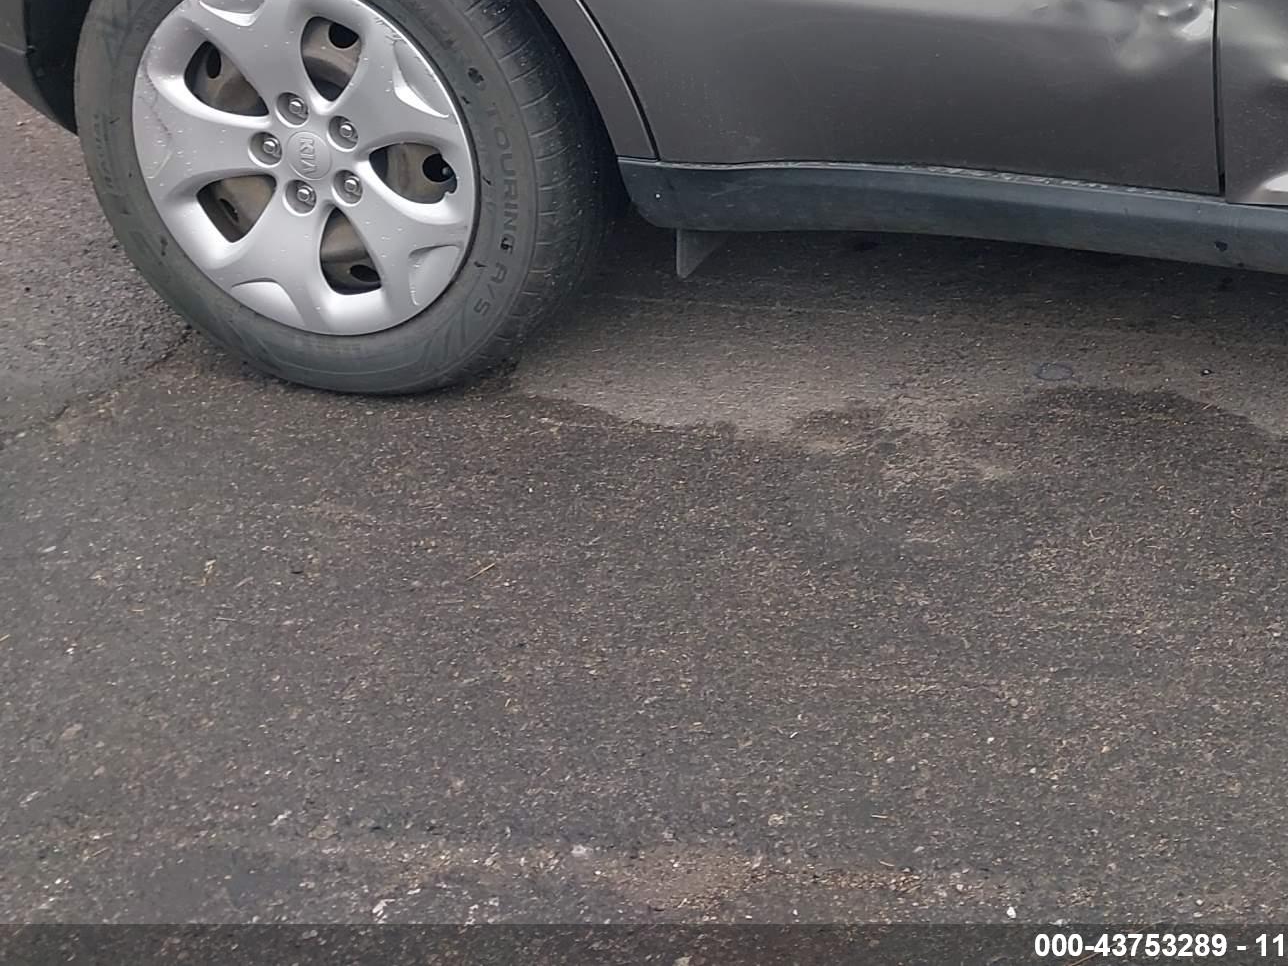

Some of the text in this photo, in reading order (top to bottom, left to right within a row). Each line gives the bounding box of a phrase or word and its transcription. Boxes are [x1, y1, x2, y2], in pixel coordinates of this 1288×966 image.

[299, 137, 317, 175] KIA
[473, 105, 519, 316] TOURING A/S
